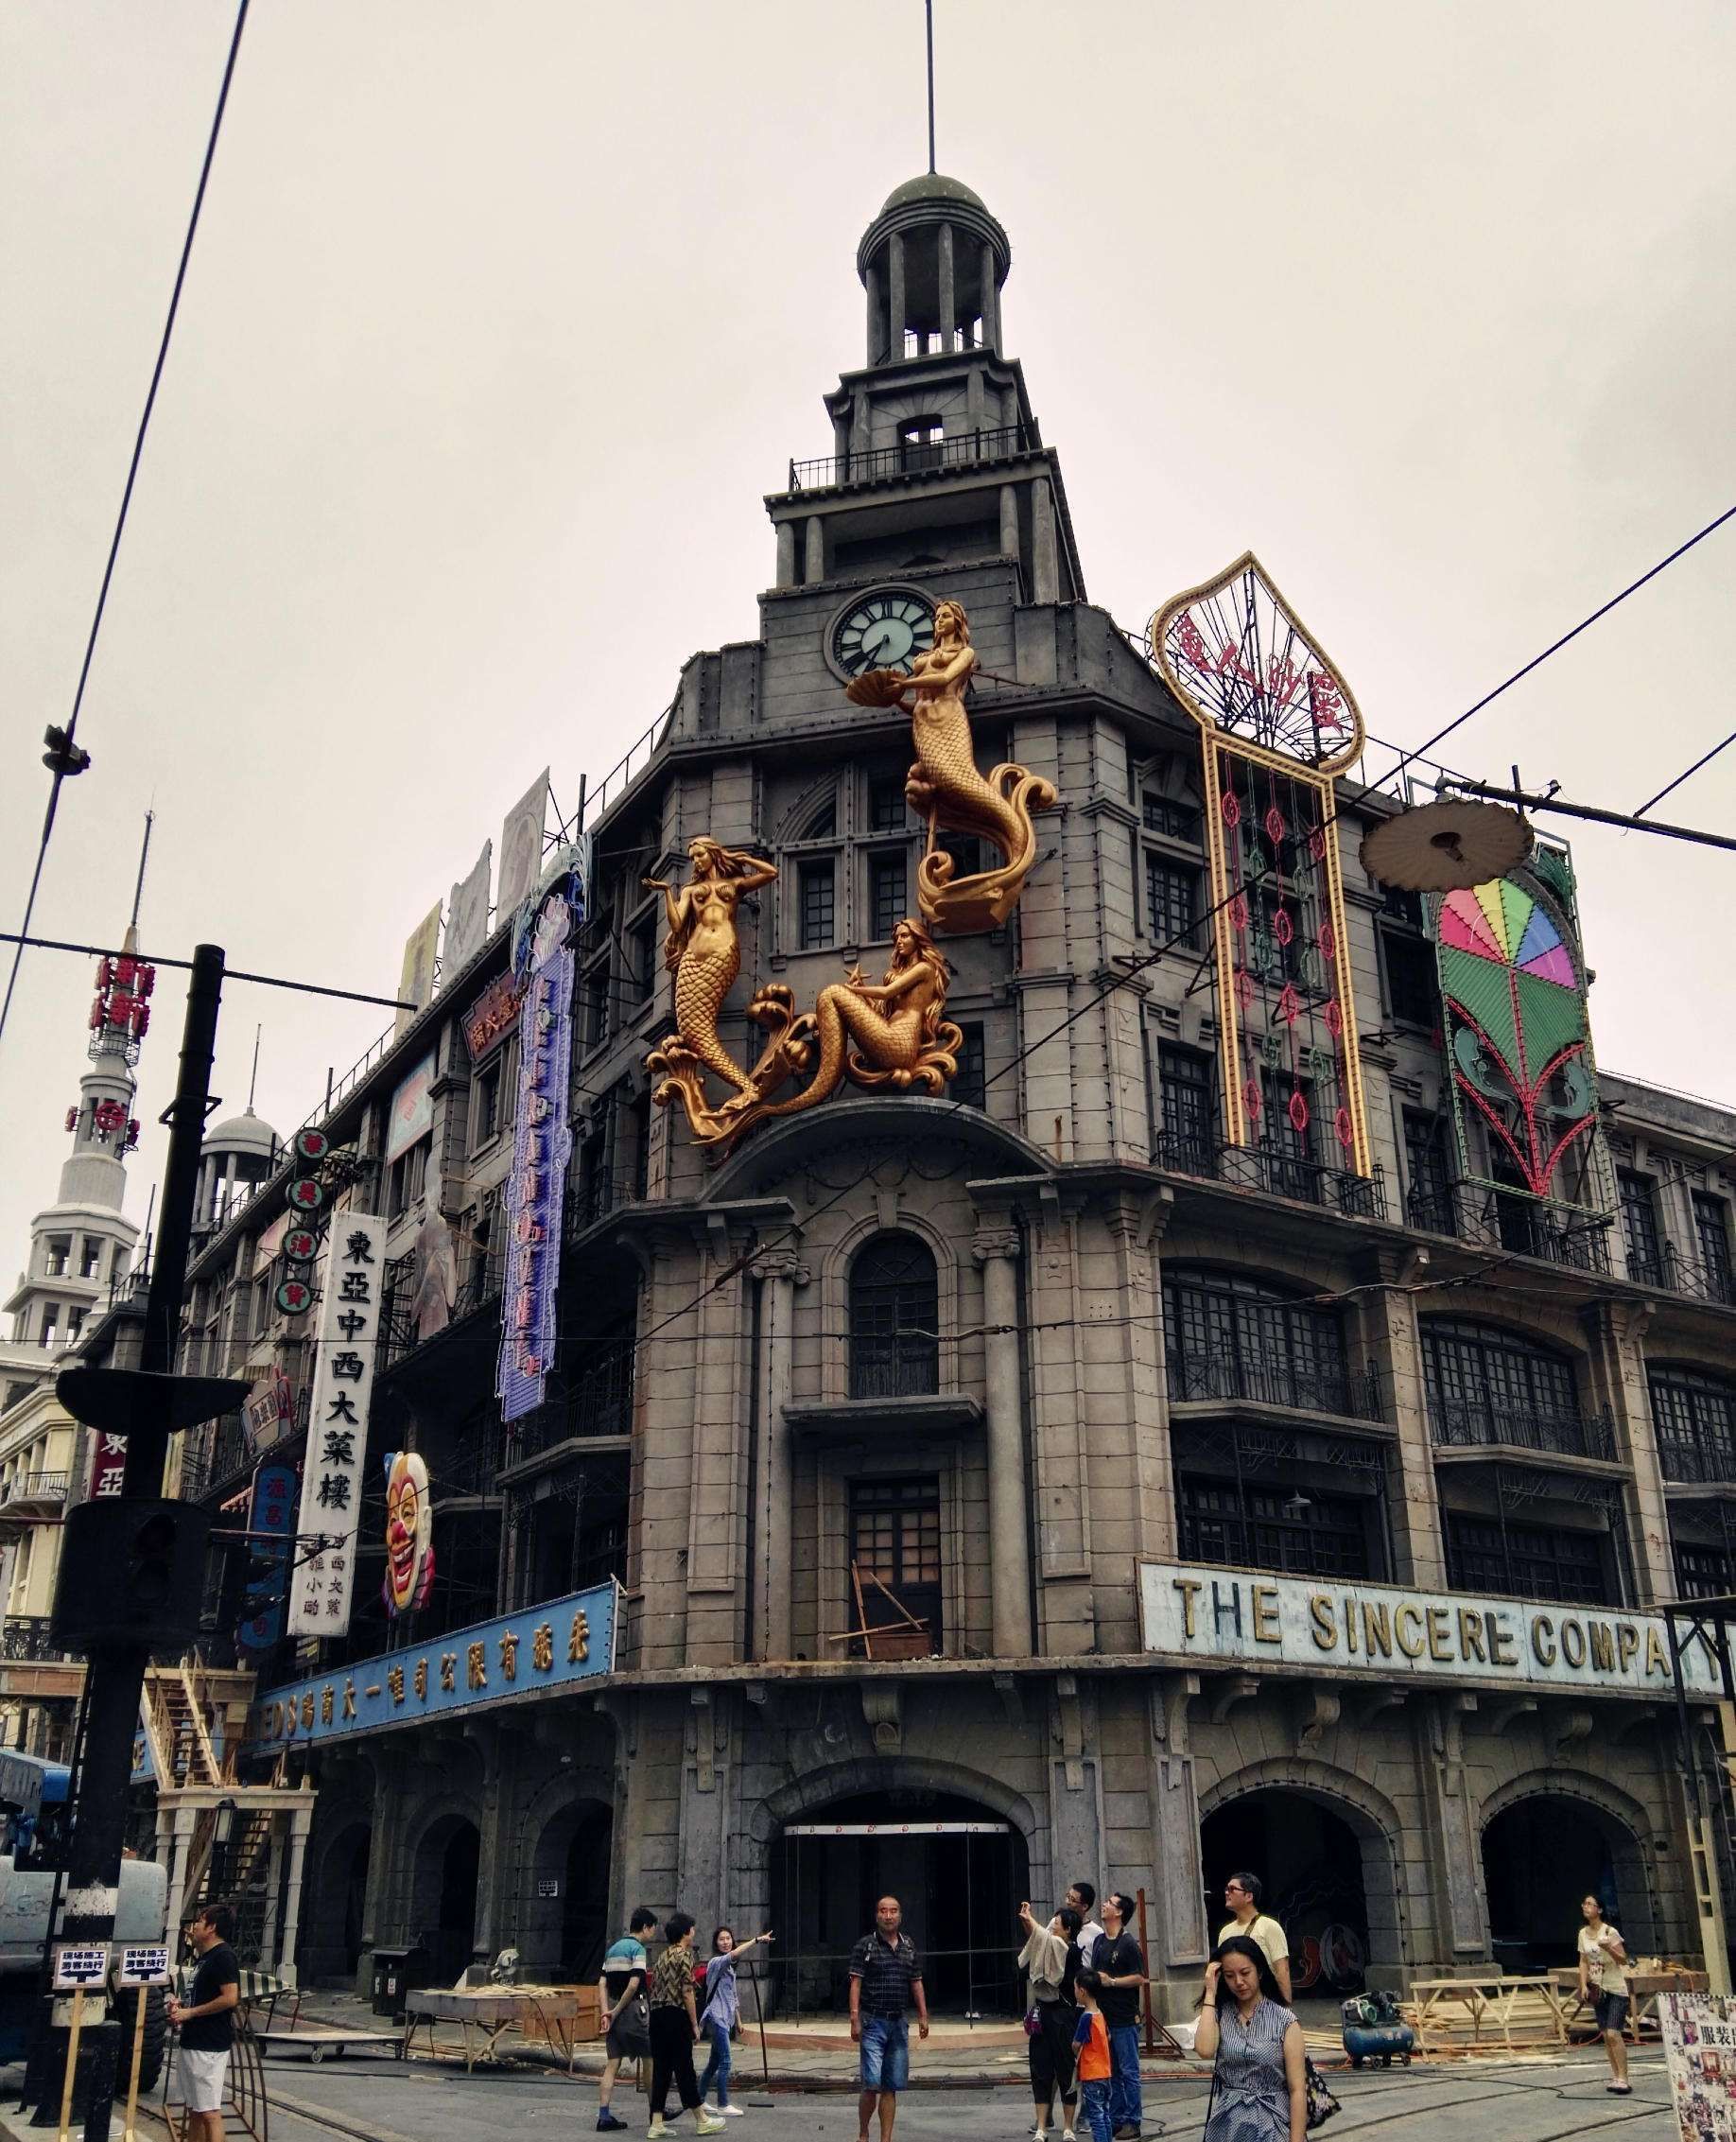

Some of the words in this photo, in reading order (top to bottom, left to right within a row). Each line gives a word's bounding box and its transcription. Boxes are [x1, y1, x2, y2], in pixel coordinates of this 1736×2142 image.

[316, 1230, 374, 1510] 東亞中西大菜樓
[1173, 1578, 1283, 1643] THE
[1311, 1594, 1519, 1666] SINCERE
[1531, 1613, 1718, 1681] COMPAY
[1701, 2026, 1736, 2046] 服装
